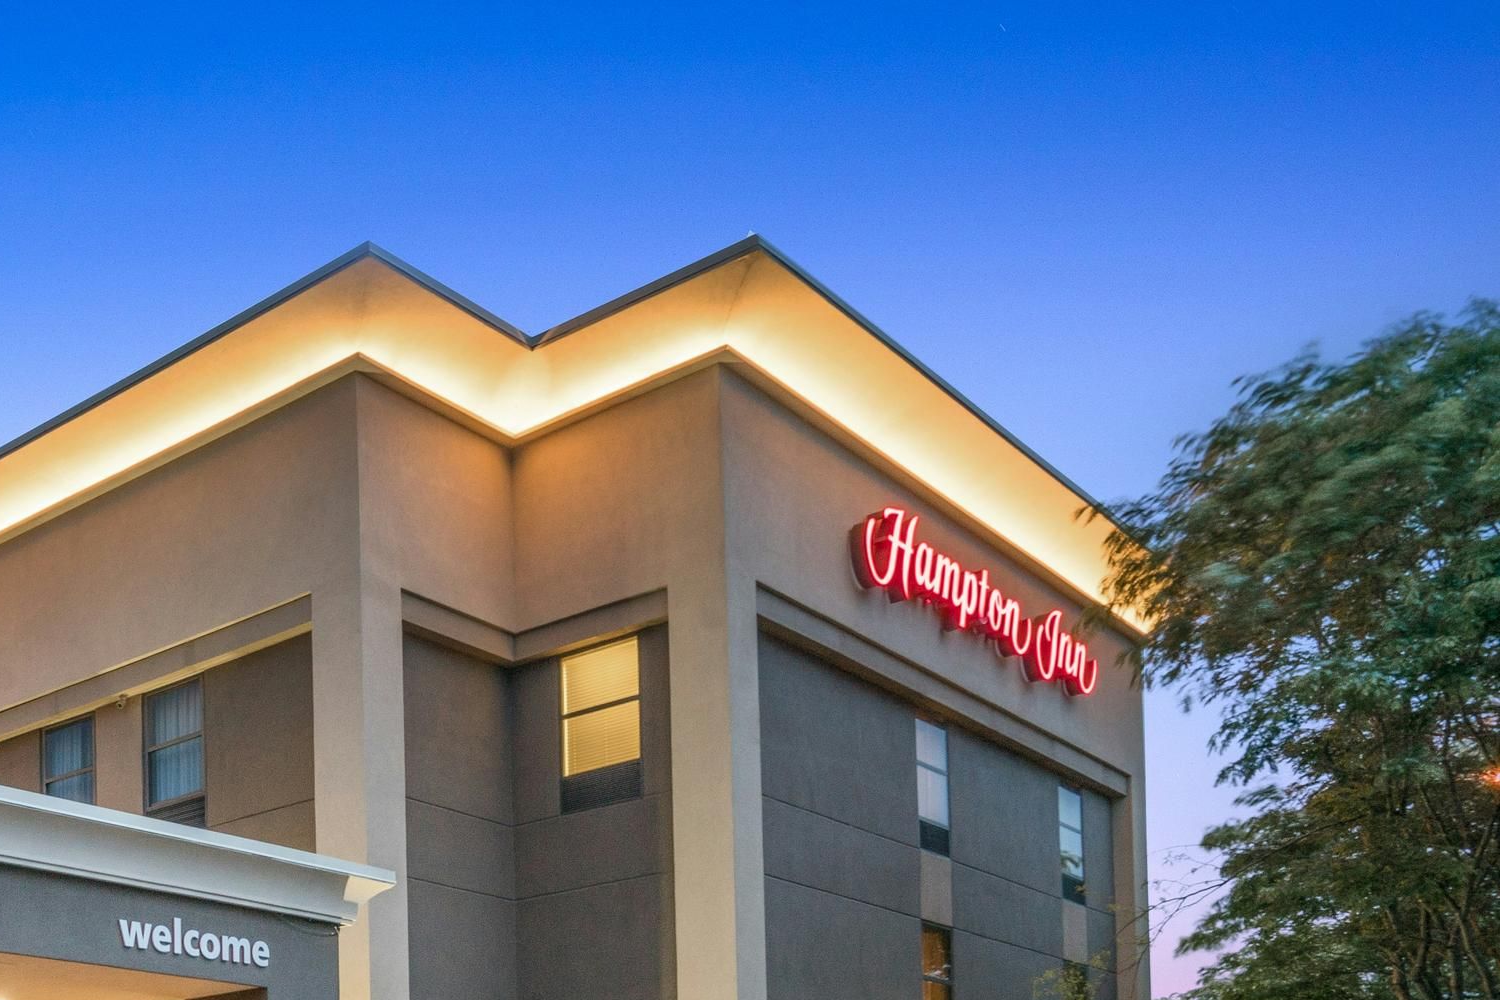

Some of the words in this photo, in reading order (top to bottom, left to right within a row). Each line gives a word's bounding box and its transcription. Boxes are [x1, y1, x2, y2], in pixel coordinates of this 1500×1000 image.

[862, 506, 1032, 656] Hampton
[1036, 610, 1097, 694] Inn
[118, 917, 270, 967] welcome
